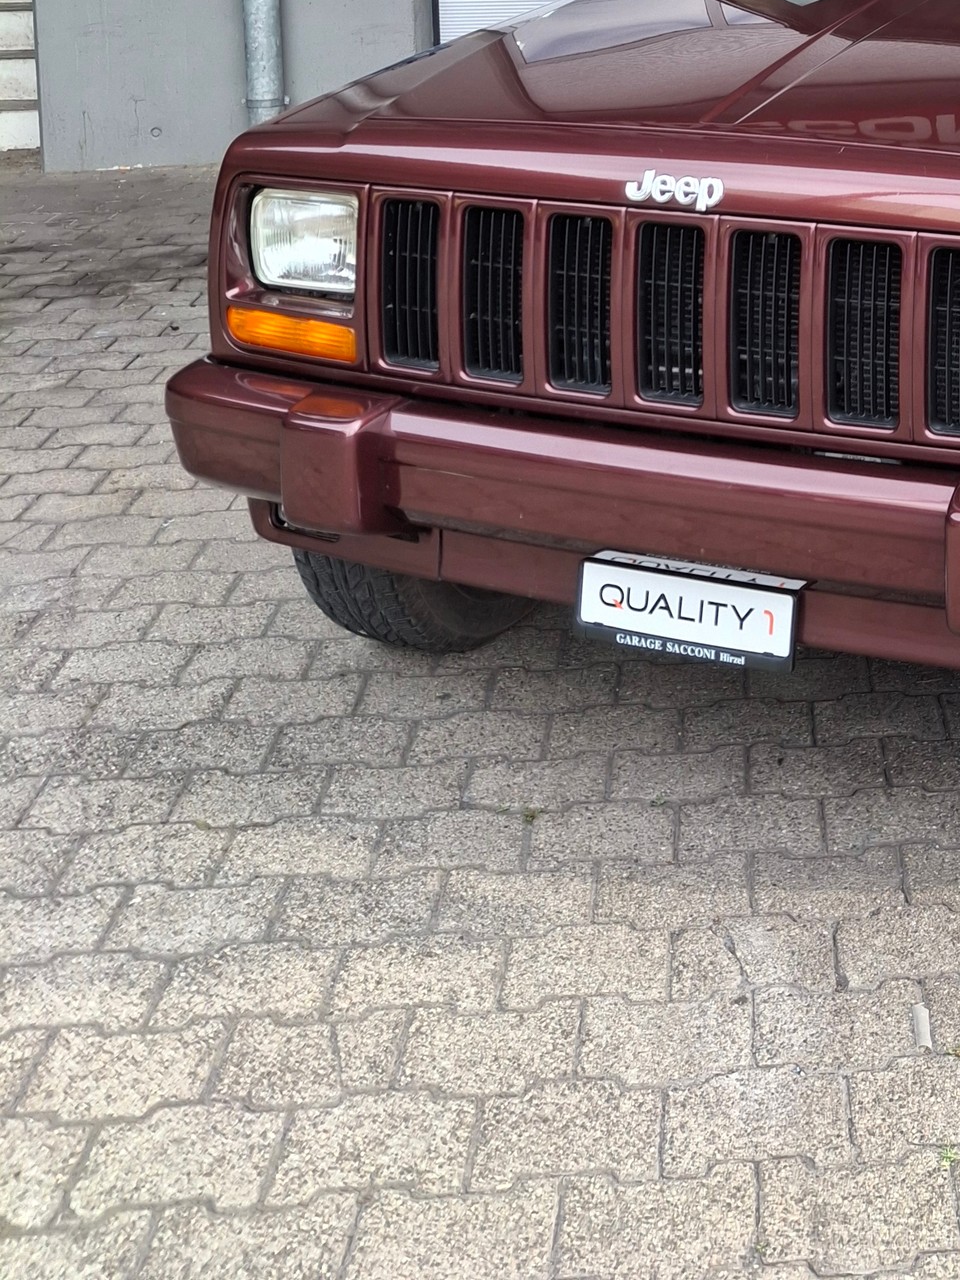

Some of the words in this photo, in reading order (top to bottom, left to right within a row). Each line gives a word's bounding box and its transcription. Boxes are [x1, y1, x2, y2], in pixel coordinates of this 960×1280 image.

[625, 169, 724, 212] Jeep
[599, 583, 754, 630] QUALITY
[616, 633, 663, 651] GARAGE
[666, 642, 716, 661] SACCONI
[720, 652, 746, 666] Hirzel
